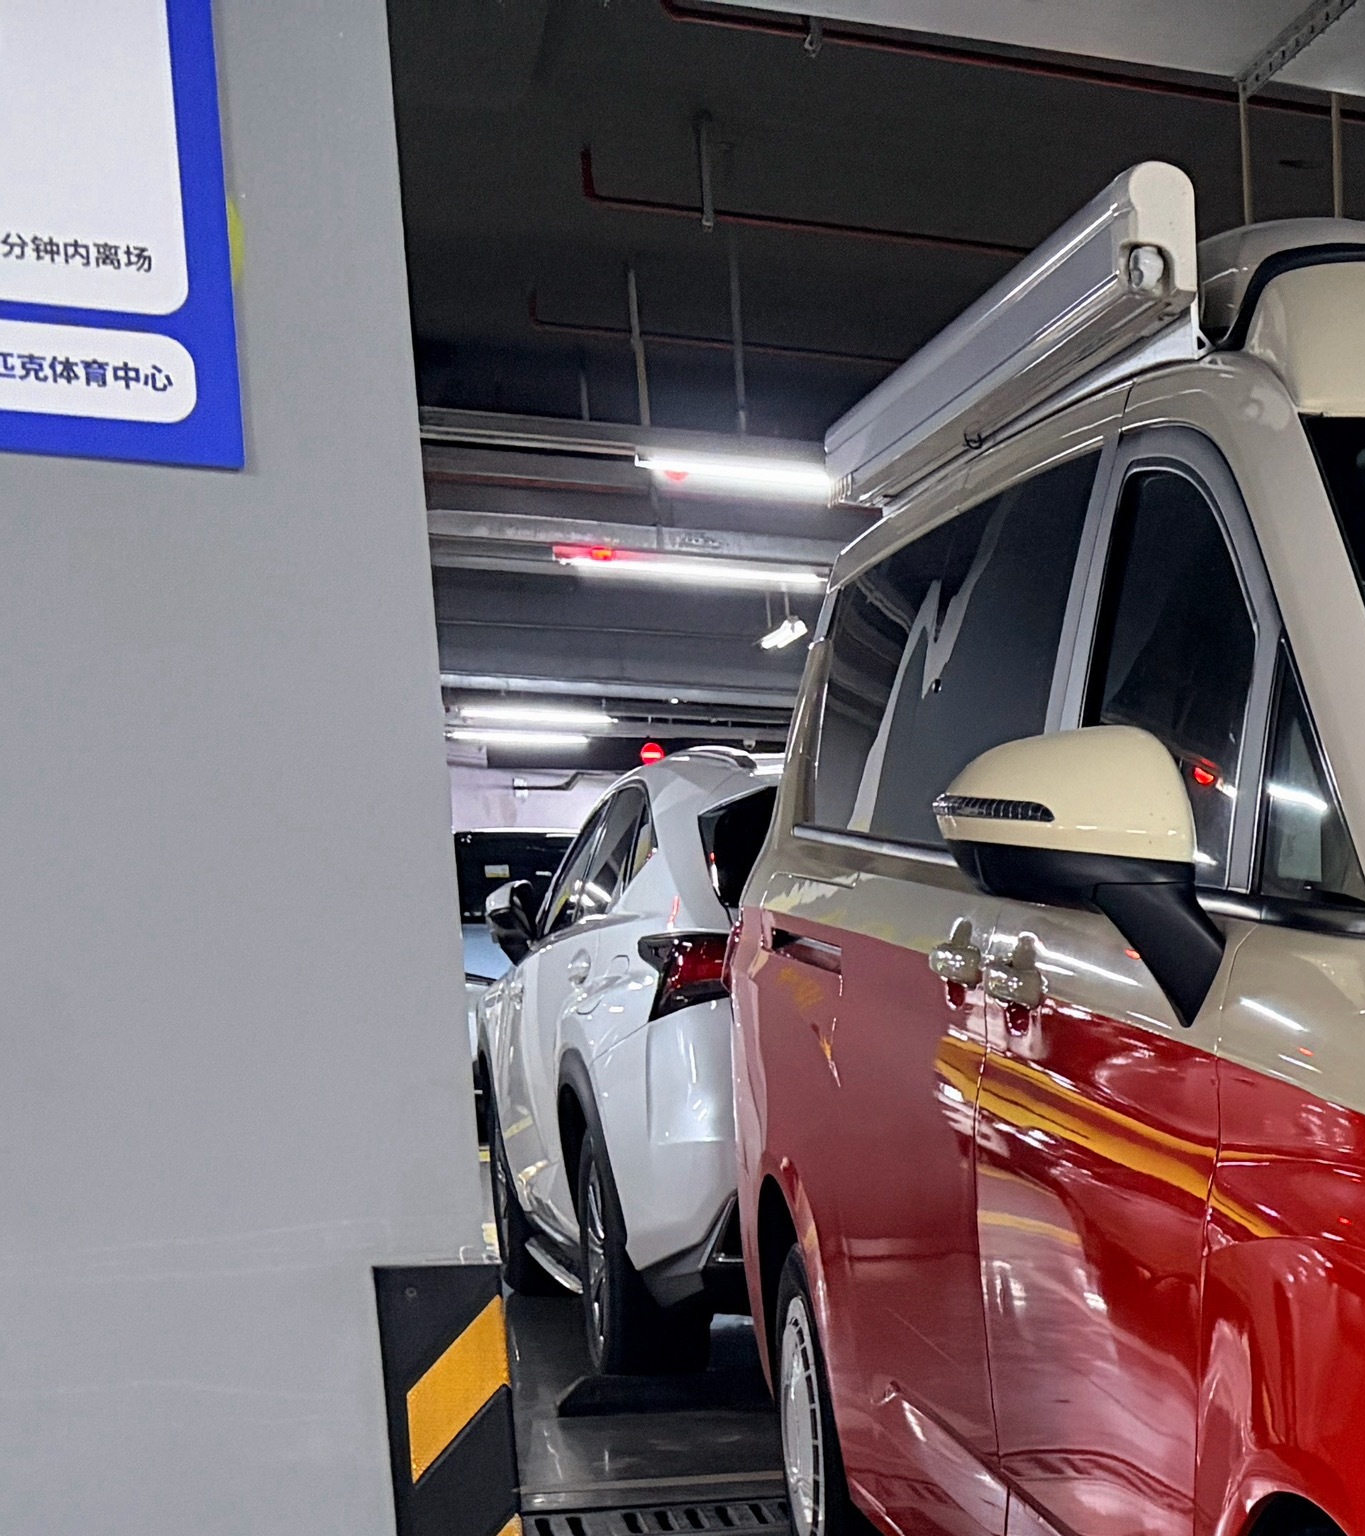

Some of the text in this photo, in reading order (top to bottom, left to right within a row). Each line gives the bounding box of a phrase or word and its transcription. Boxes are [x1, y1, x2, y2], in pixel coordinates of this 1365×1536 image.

[0, 233, 153, 273] 分钟内离场
